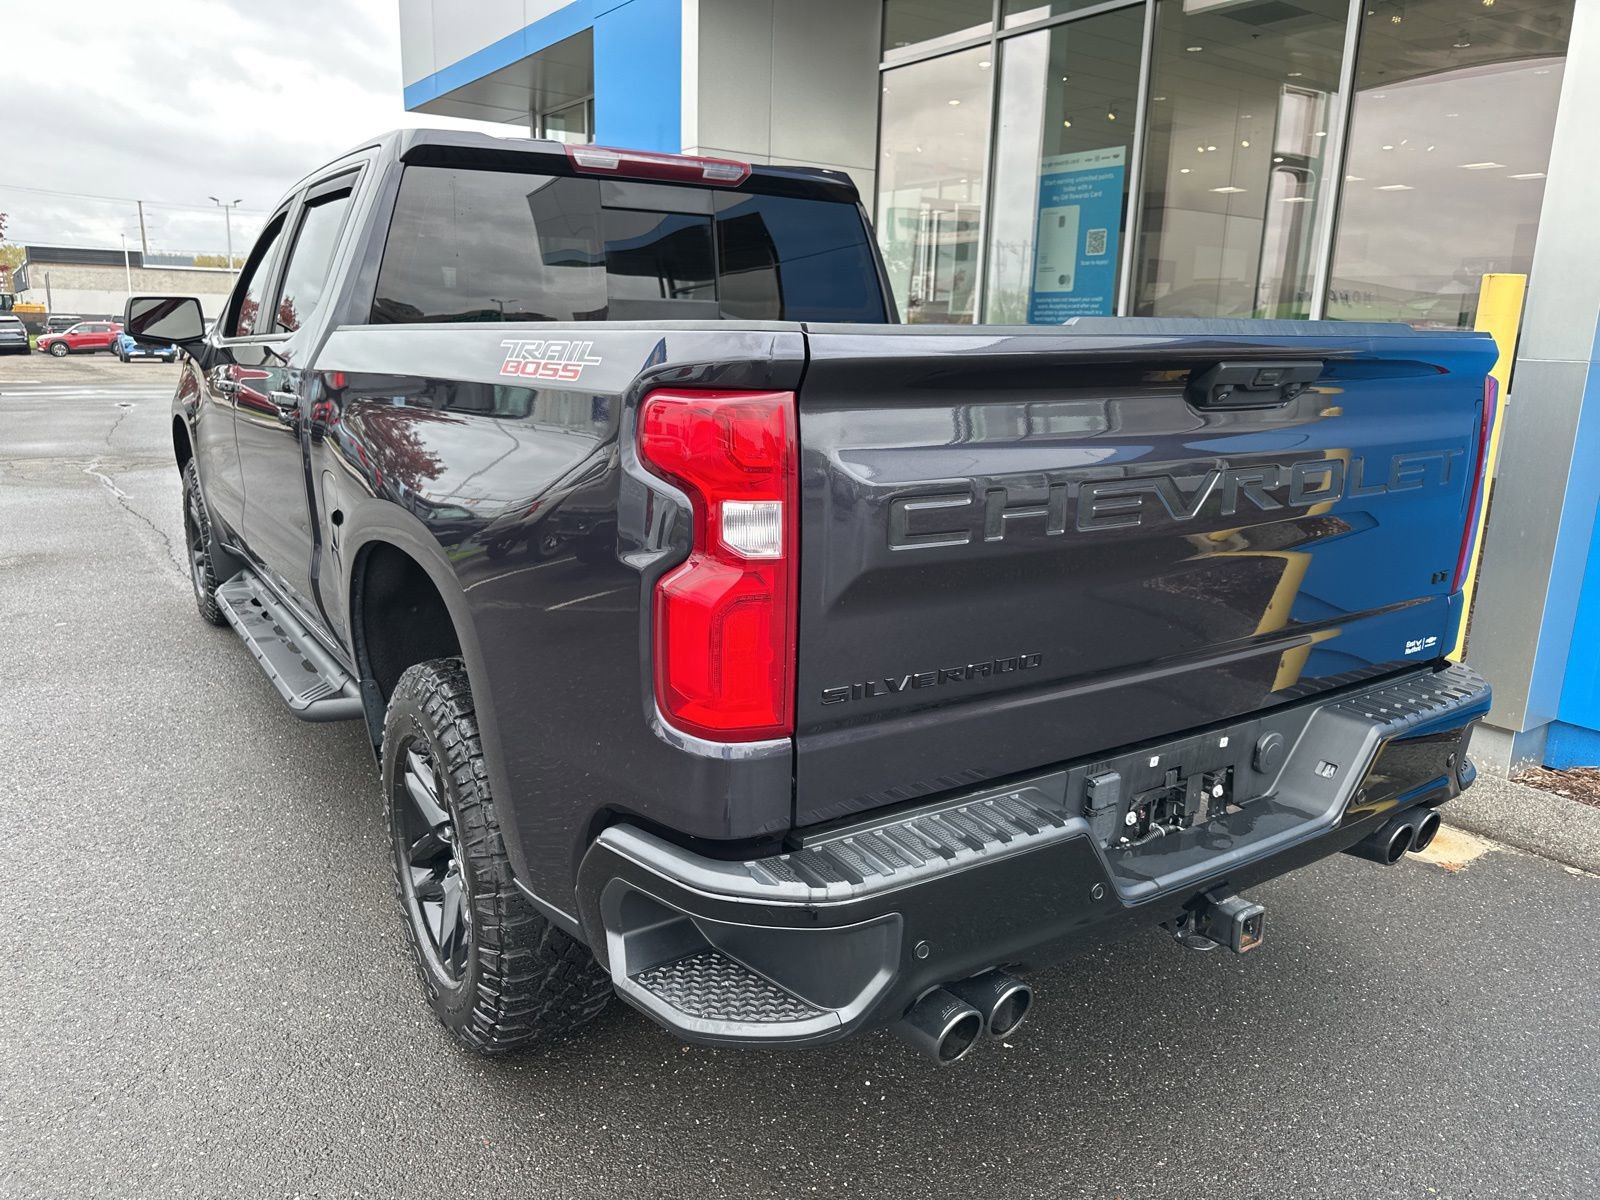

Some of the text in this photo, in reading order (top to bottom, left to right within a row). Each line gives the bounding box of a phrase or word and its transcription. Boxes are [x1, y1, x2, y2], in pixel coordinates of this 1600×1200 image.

[500, 359, 584, 381] BOSS
[501, 340, 602, 365] TRAIL
[888, 447, 1465, 551] CHEVROLET
[822, 652, 1043, 705] SILVERADO
